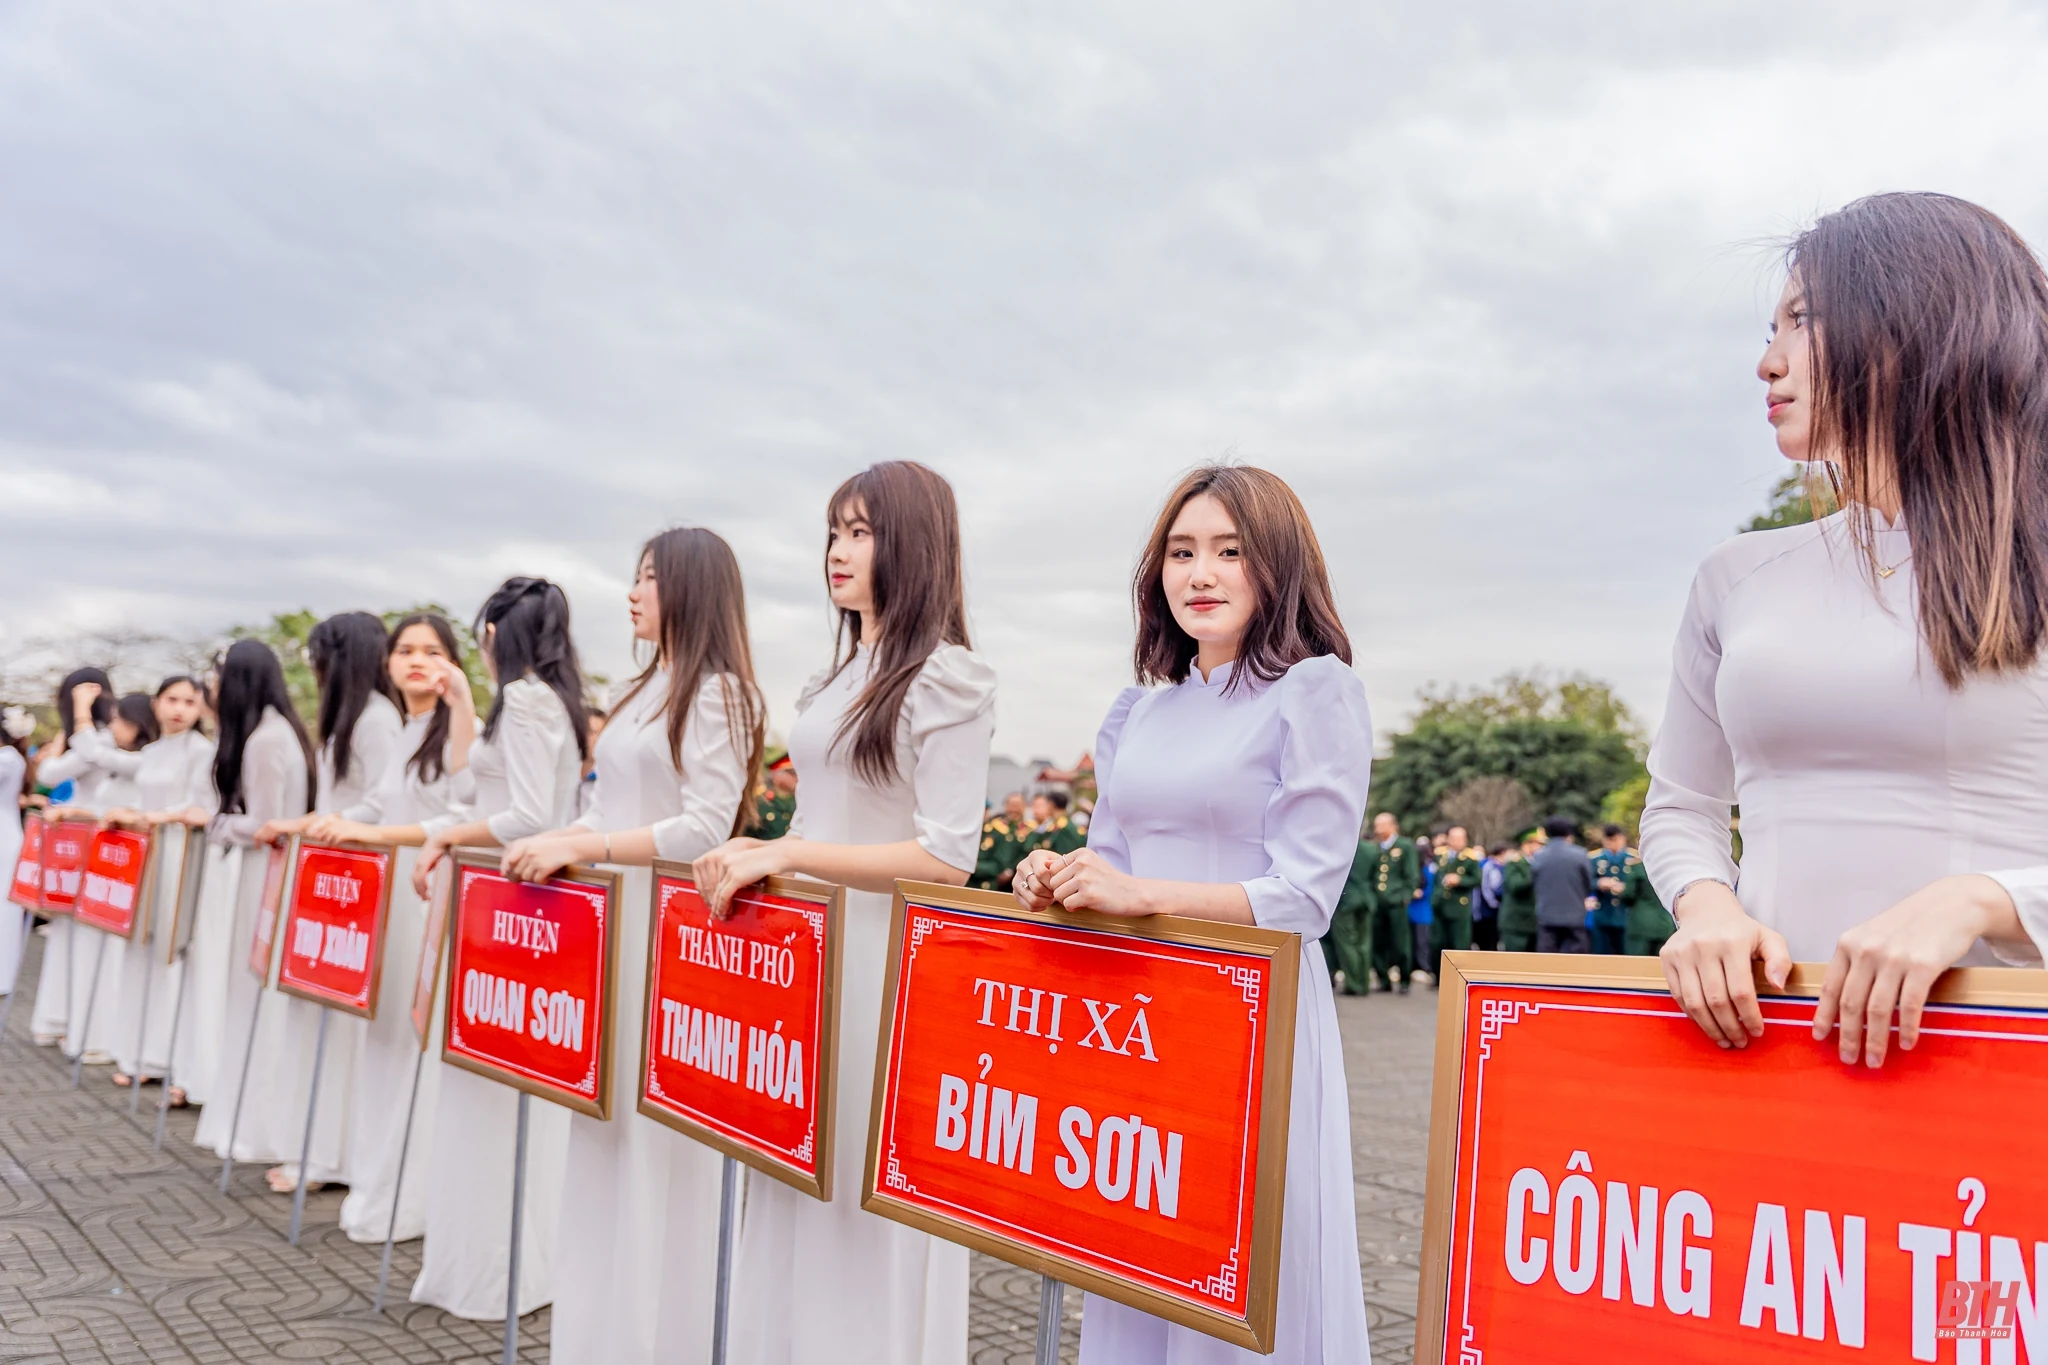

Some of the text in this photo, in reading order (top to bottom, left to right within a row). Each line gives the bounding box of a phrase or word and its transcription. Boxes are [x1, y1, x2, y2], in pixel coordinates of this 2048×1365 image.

[492, 908, 560, 959] HUYỆN
[678, 919, 795, 989] THÀNH PHỐ
[463, 968, 585, 1052] QUAN SƠN
[660, 997, 805, 1109] THANH HÓA
[973, 977, 1159, 1063] THỊ XÃ
[935, 1052, 1184, 1219] BỈM SƠN
[1504, 1149, 1713, 1319] CÔNG
[1739, 1202, 1866, 1349] AN
